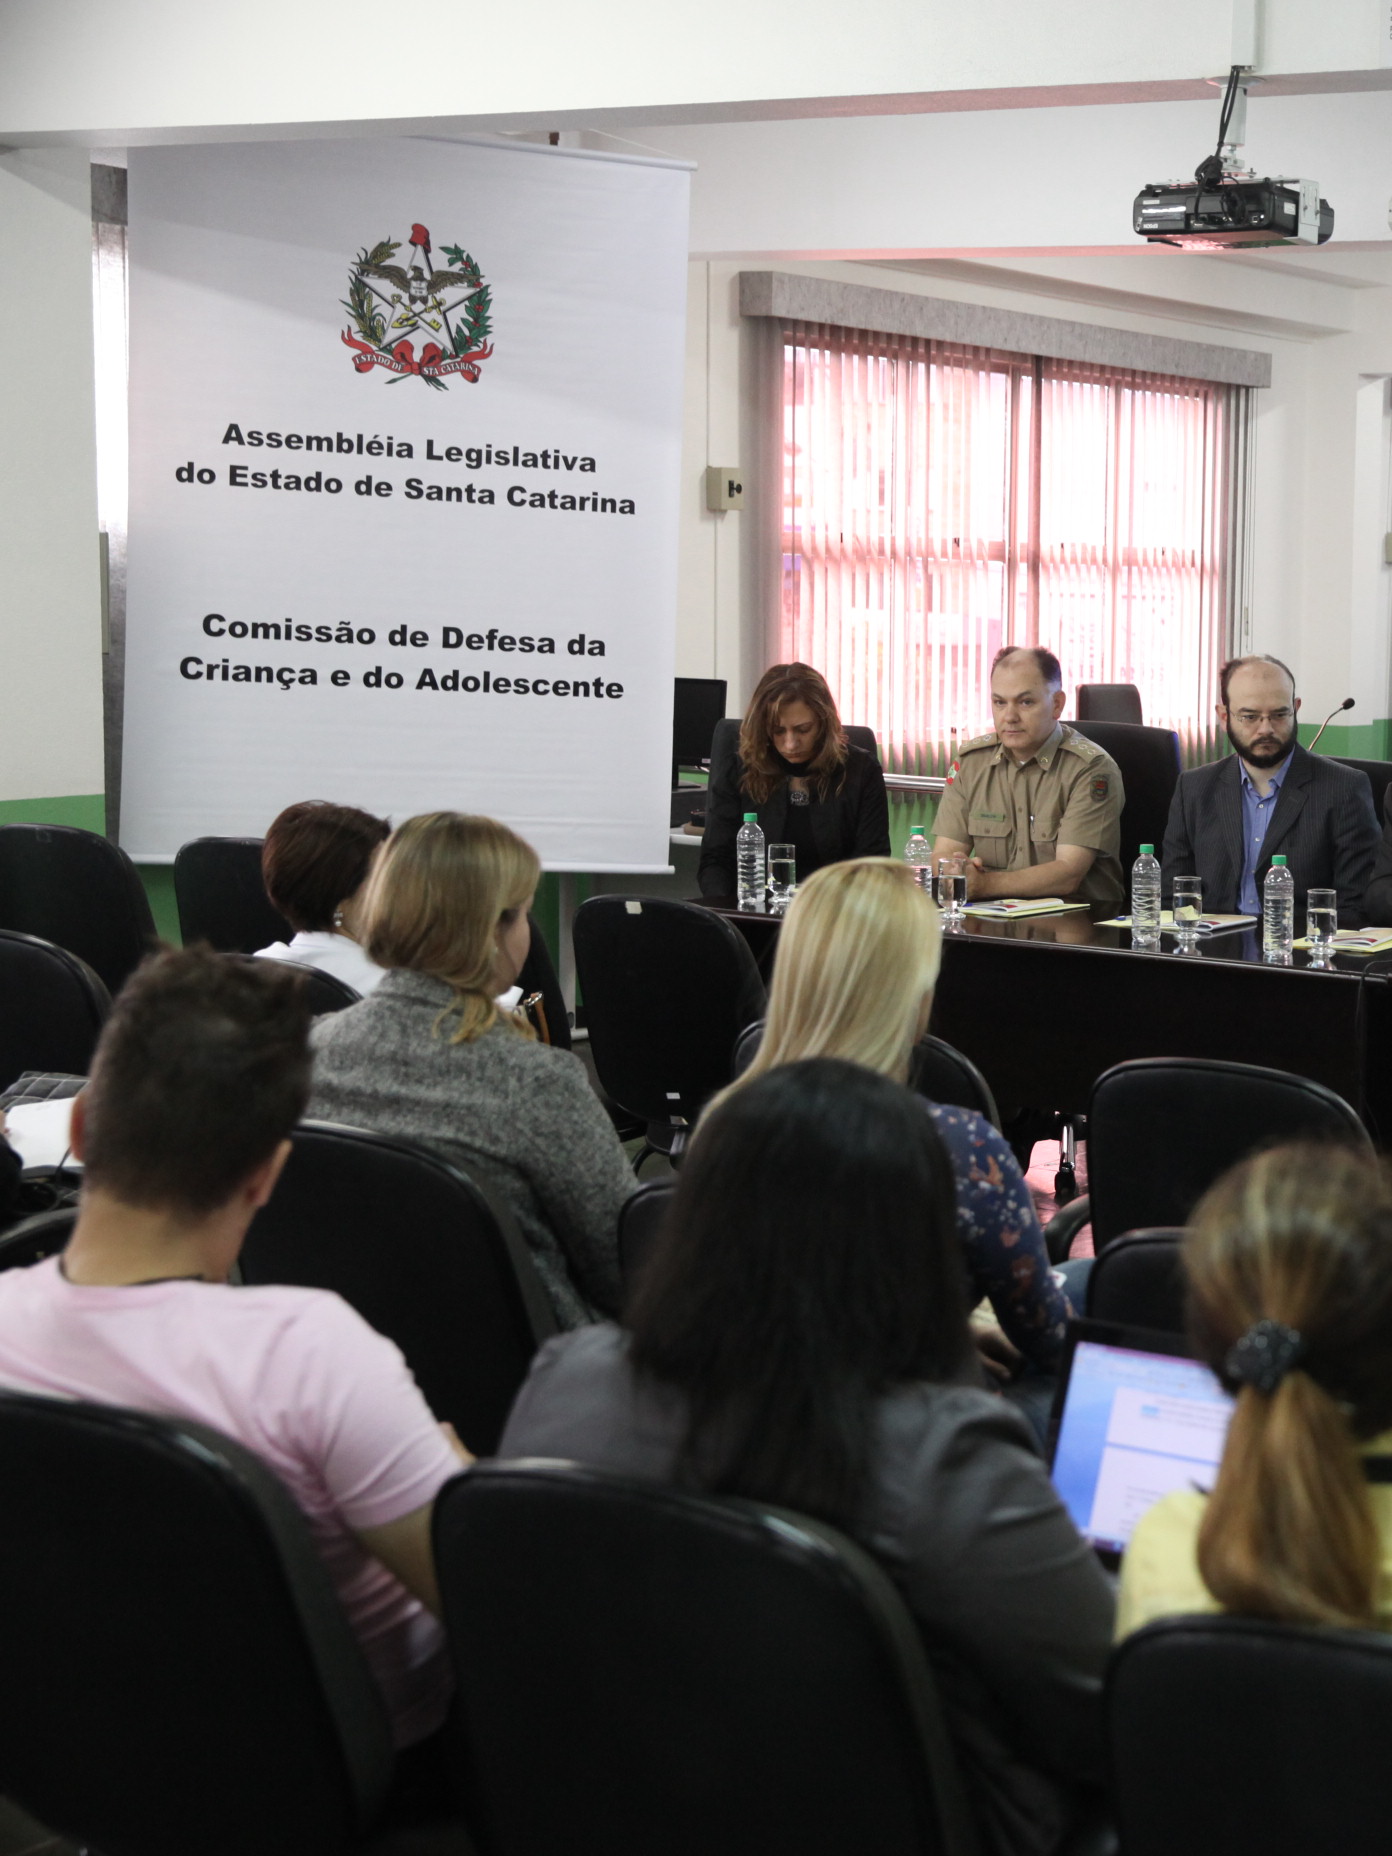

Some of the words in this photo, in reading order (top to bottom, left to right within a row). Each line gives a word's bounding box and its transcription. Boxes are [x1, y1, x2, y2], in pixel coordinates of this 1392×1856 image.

[355, 354, 390, 366] ESTADO
[423, 367, 439, 376] STA
[441, 362, 478, 375] CATARINA
[222, 423, 414, 459] Assembléia
[426, 439, 596, 473] Legislativa
[175, 461, 216, 485] do
[229, 464, 343, 494] Estado
[354, 475, 393, 498] de
[404, 478, 495, 505] Santa
[506, 485, 636, 515] Catarina
[202, 613, 376, 646] Comissão
[388, 624, 429, 648] de
[442, 626, 555, 654] Defesa
[567, 633, 606, 657] da
[179, 656, 318, 691] Criança
[330, 669, 351, 687] e
[362, 665, 404, 689] do
[415, 668, 624, 699] Adolescente
